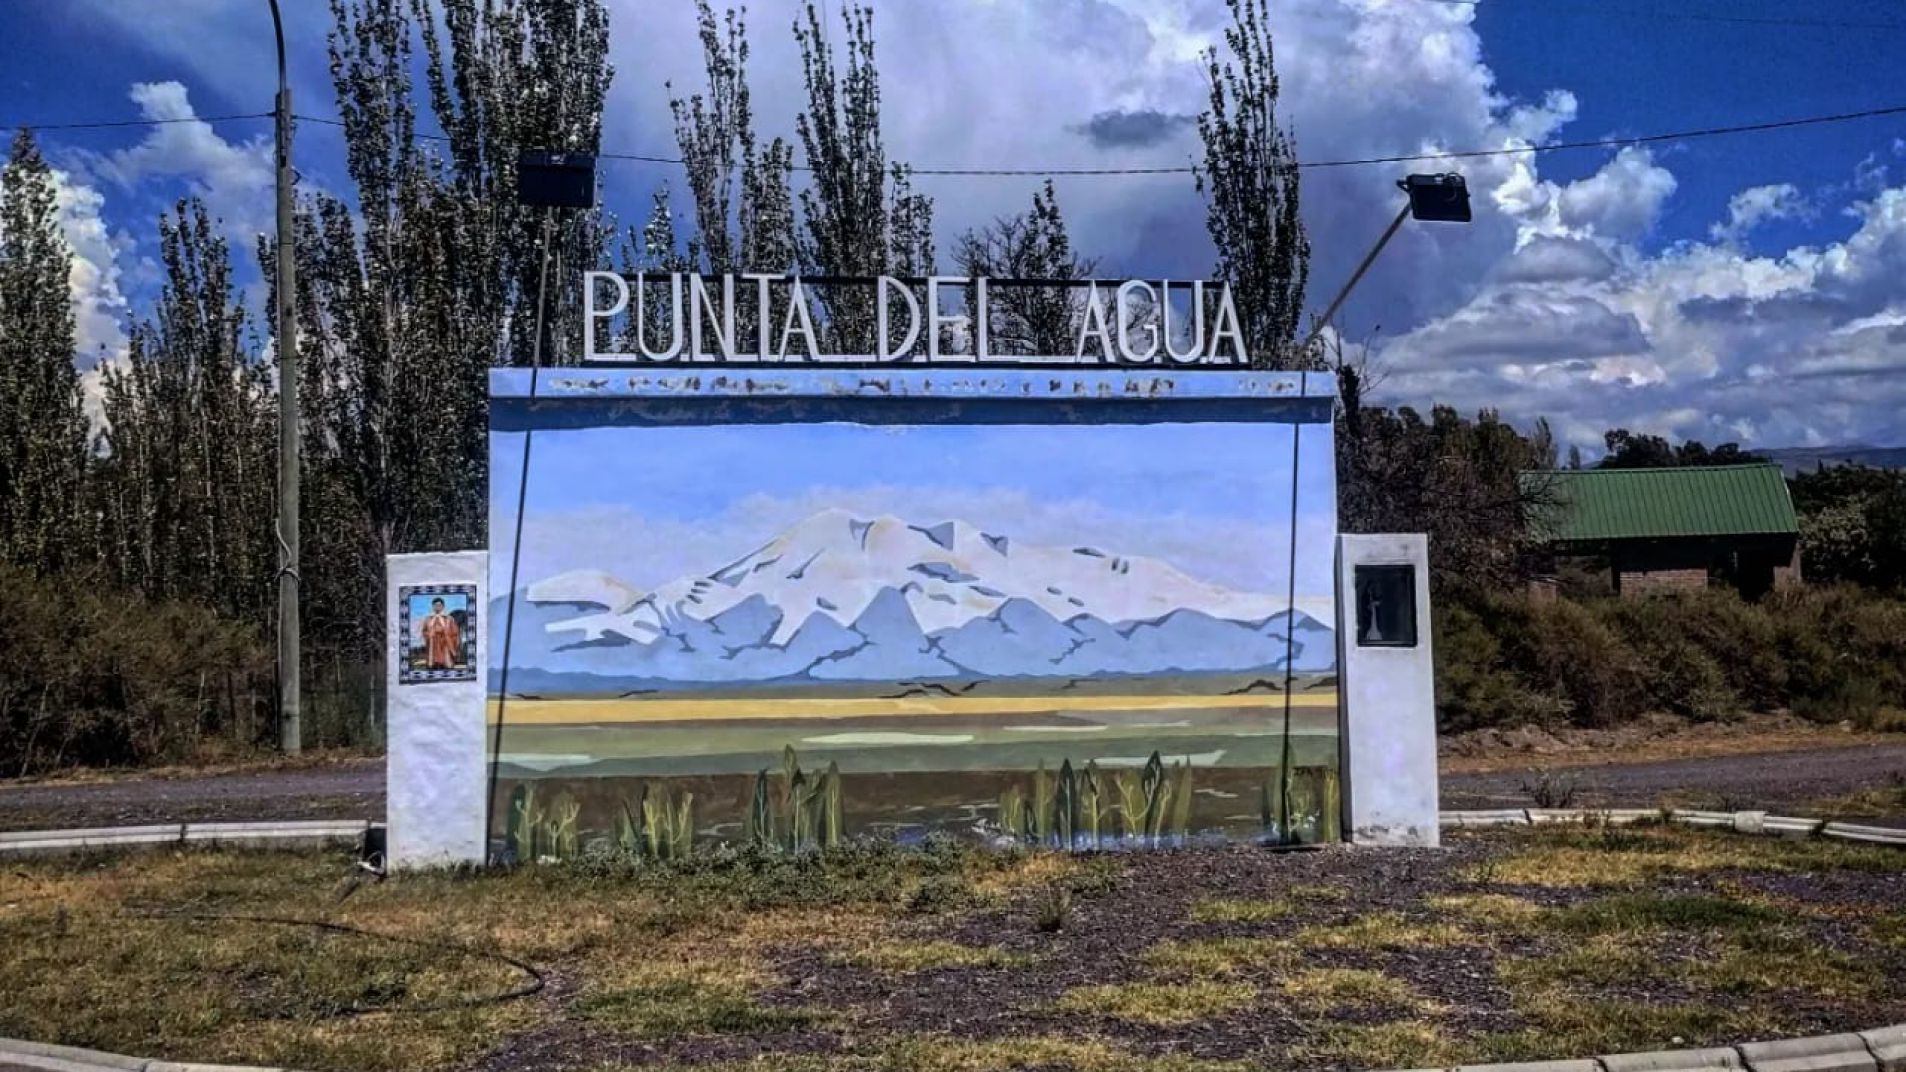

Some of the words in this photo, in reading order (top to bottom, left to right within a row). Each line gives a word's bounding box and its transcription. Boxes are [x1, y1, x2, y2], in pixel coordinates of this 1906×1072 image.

[584, 270, 820, 362] PUNTA
[878, 275, 1018, 363] DEL
[1077, 279, 1249, 363] AGUA
